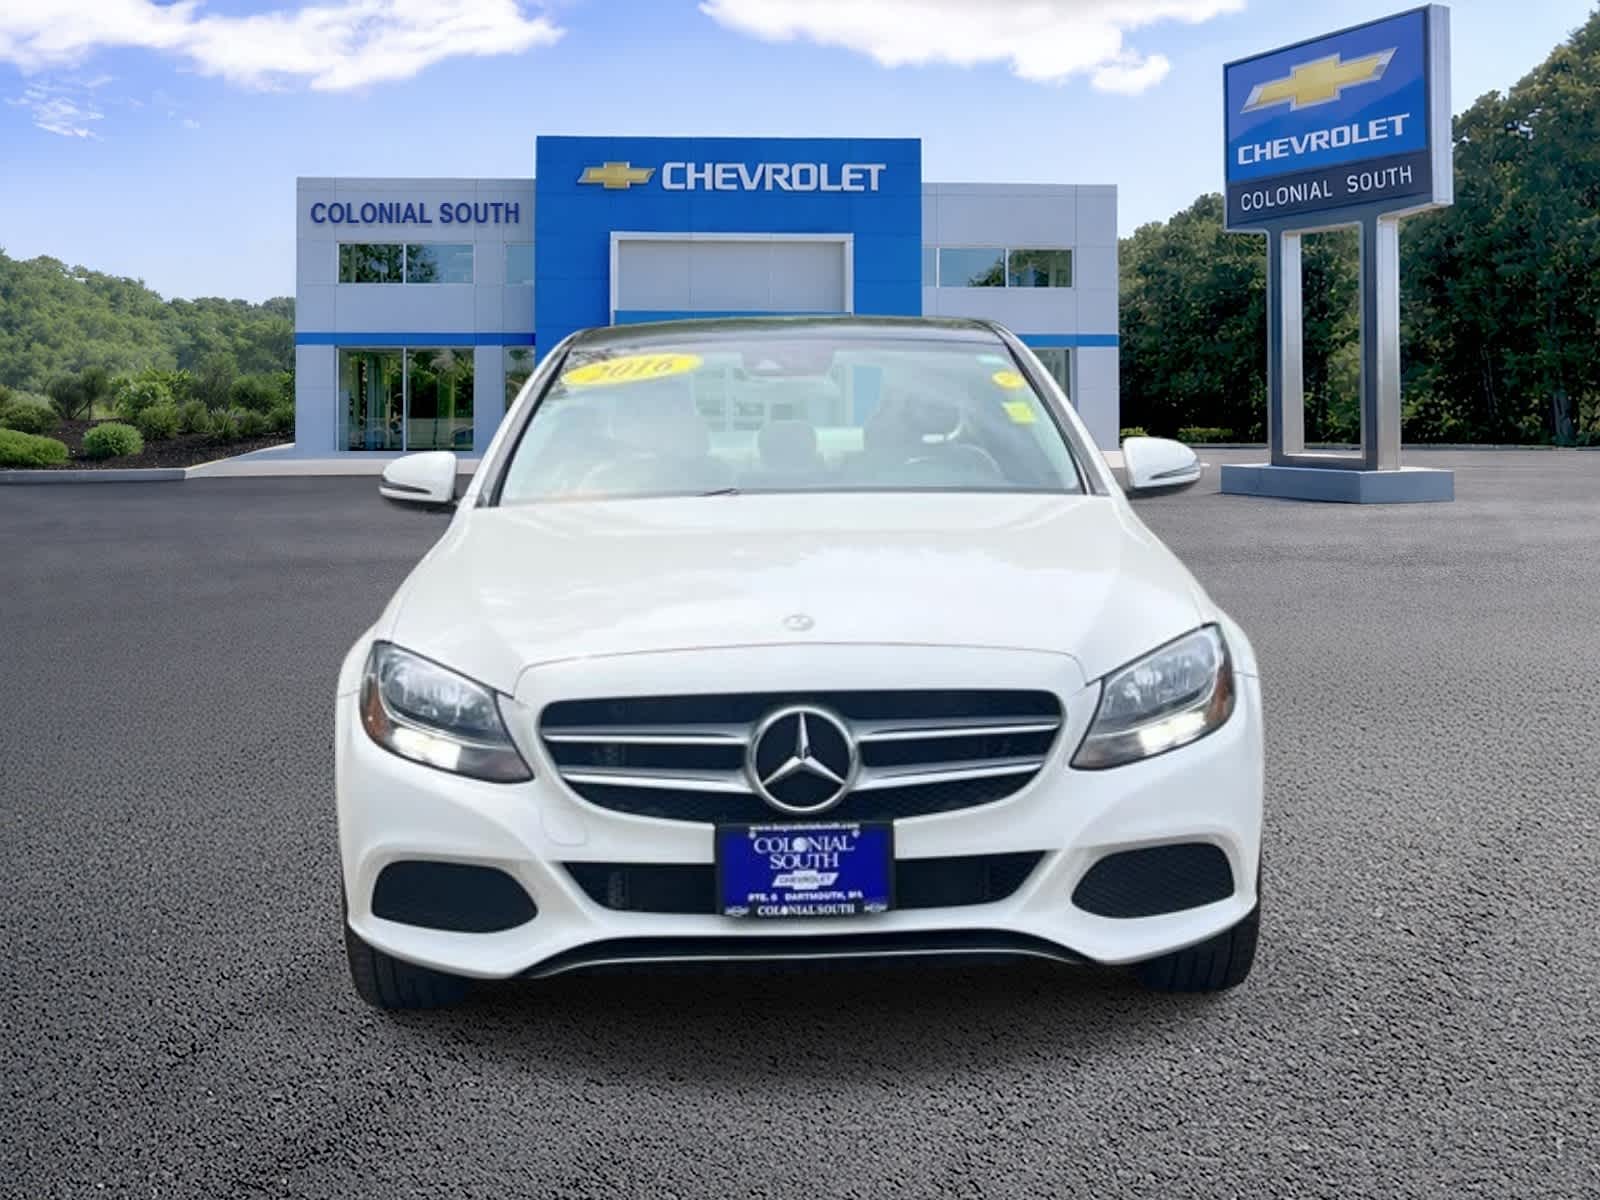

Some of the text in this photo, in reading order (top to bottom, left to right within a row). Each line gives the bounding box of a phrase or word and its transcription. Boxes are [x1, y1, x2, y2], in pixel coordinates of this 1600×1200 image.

[1237, 112, 1410, 165] CHEVROLET
[661, 161, 887, 192] CHEVROLET
[1240, 164, 1413, 211] COLONIAL SOUTH
[310, 202, 521, 225] COLONIAL SOUTH
[753, 836, 855, 854] COLONIAL
[769, 852, 839, 870] SOUTH
[757, 903, 855, 916] COLONIAL SOUTH
